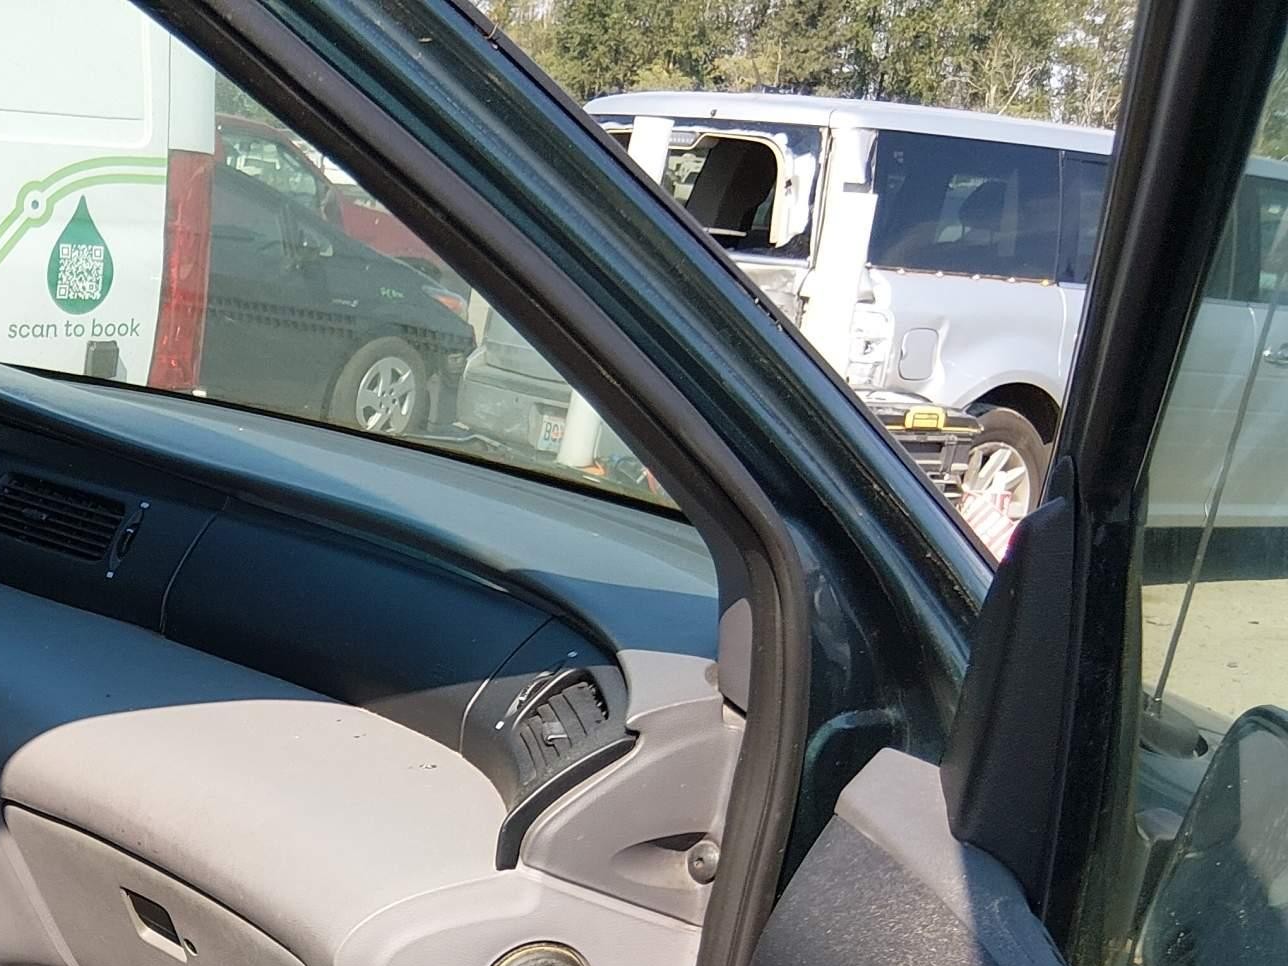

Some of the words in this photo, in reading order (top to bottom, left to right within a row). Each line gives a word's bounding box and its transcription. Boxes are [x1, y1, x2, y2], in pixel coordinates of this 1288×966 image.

[7, 323, 58, 338] scan
[64, 319, 86, 338] to
[91, 317, 141, 337] book
